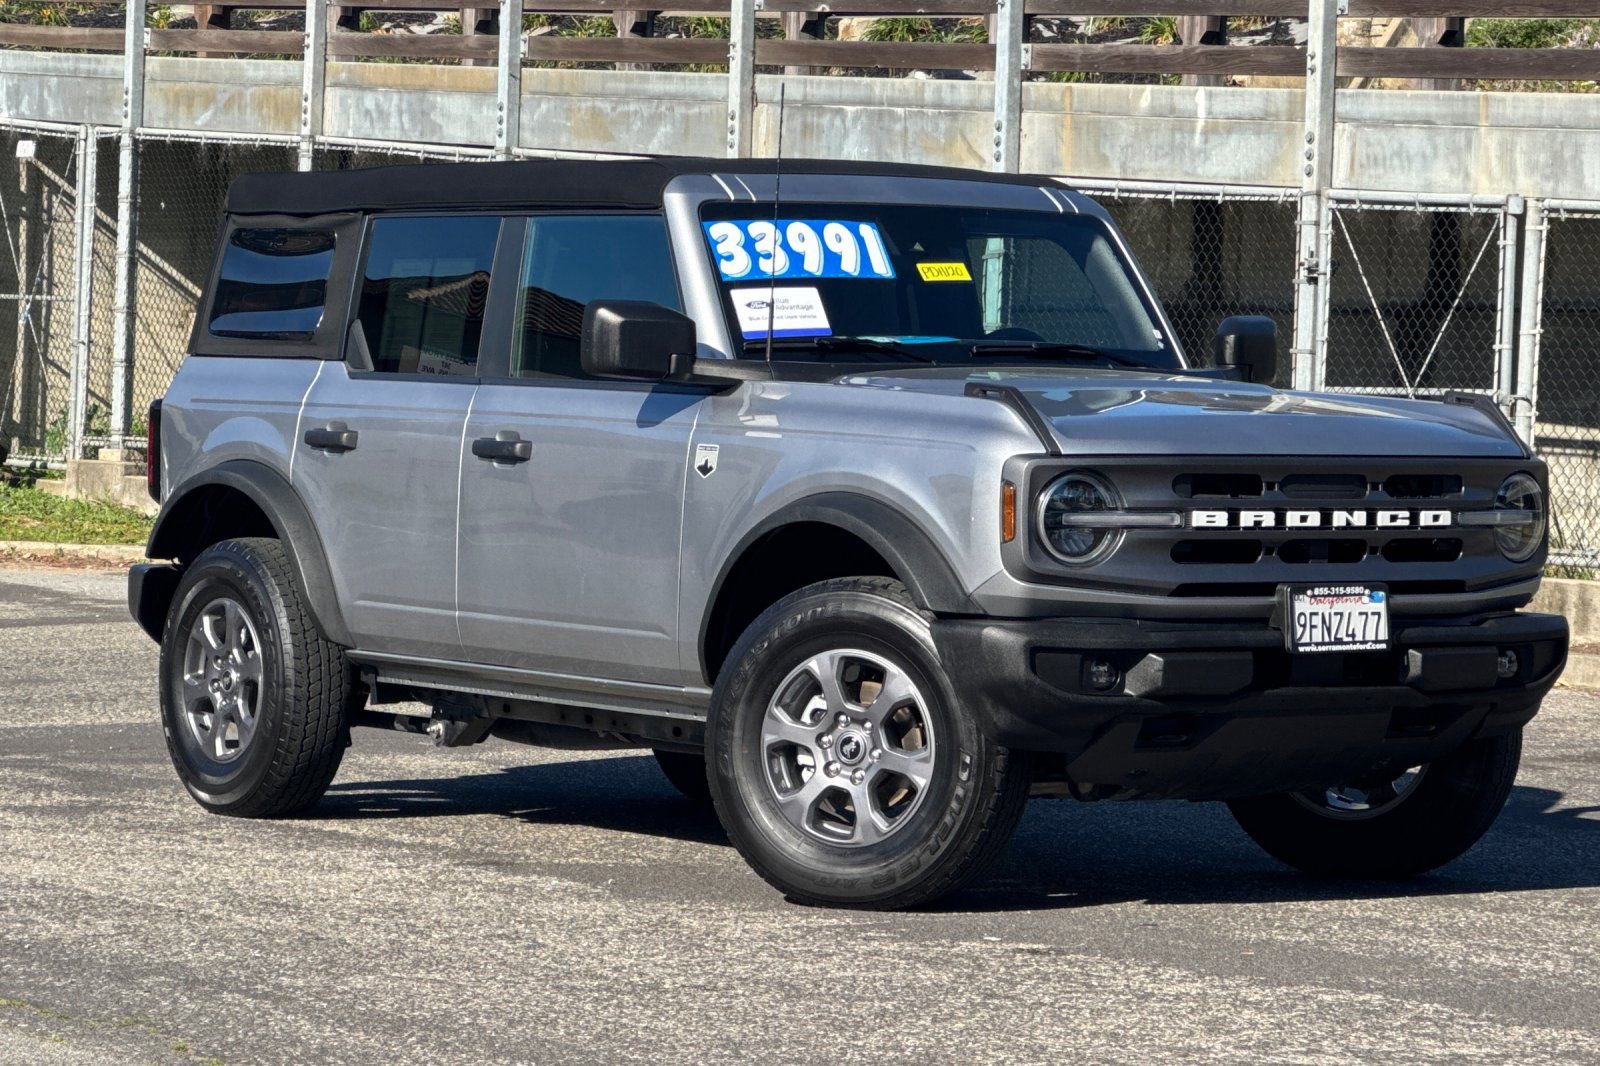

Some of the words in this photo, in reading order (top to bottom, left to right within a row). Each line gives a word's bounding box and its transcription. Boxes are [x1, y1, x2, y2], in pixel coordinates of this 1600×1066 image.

[708, 221, 892, 277] 33991
[1191, 510, 1452, 528] BRONCO
[1313, 586, 1364, 596] 855-315-9580
[1297, 611, 1382, 642] 9FNZ477
[1298, 642, 1387, 652] www.serramonteford.com
